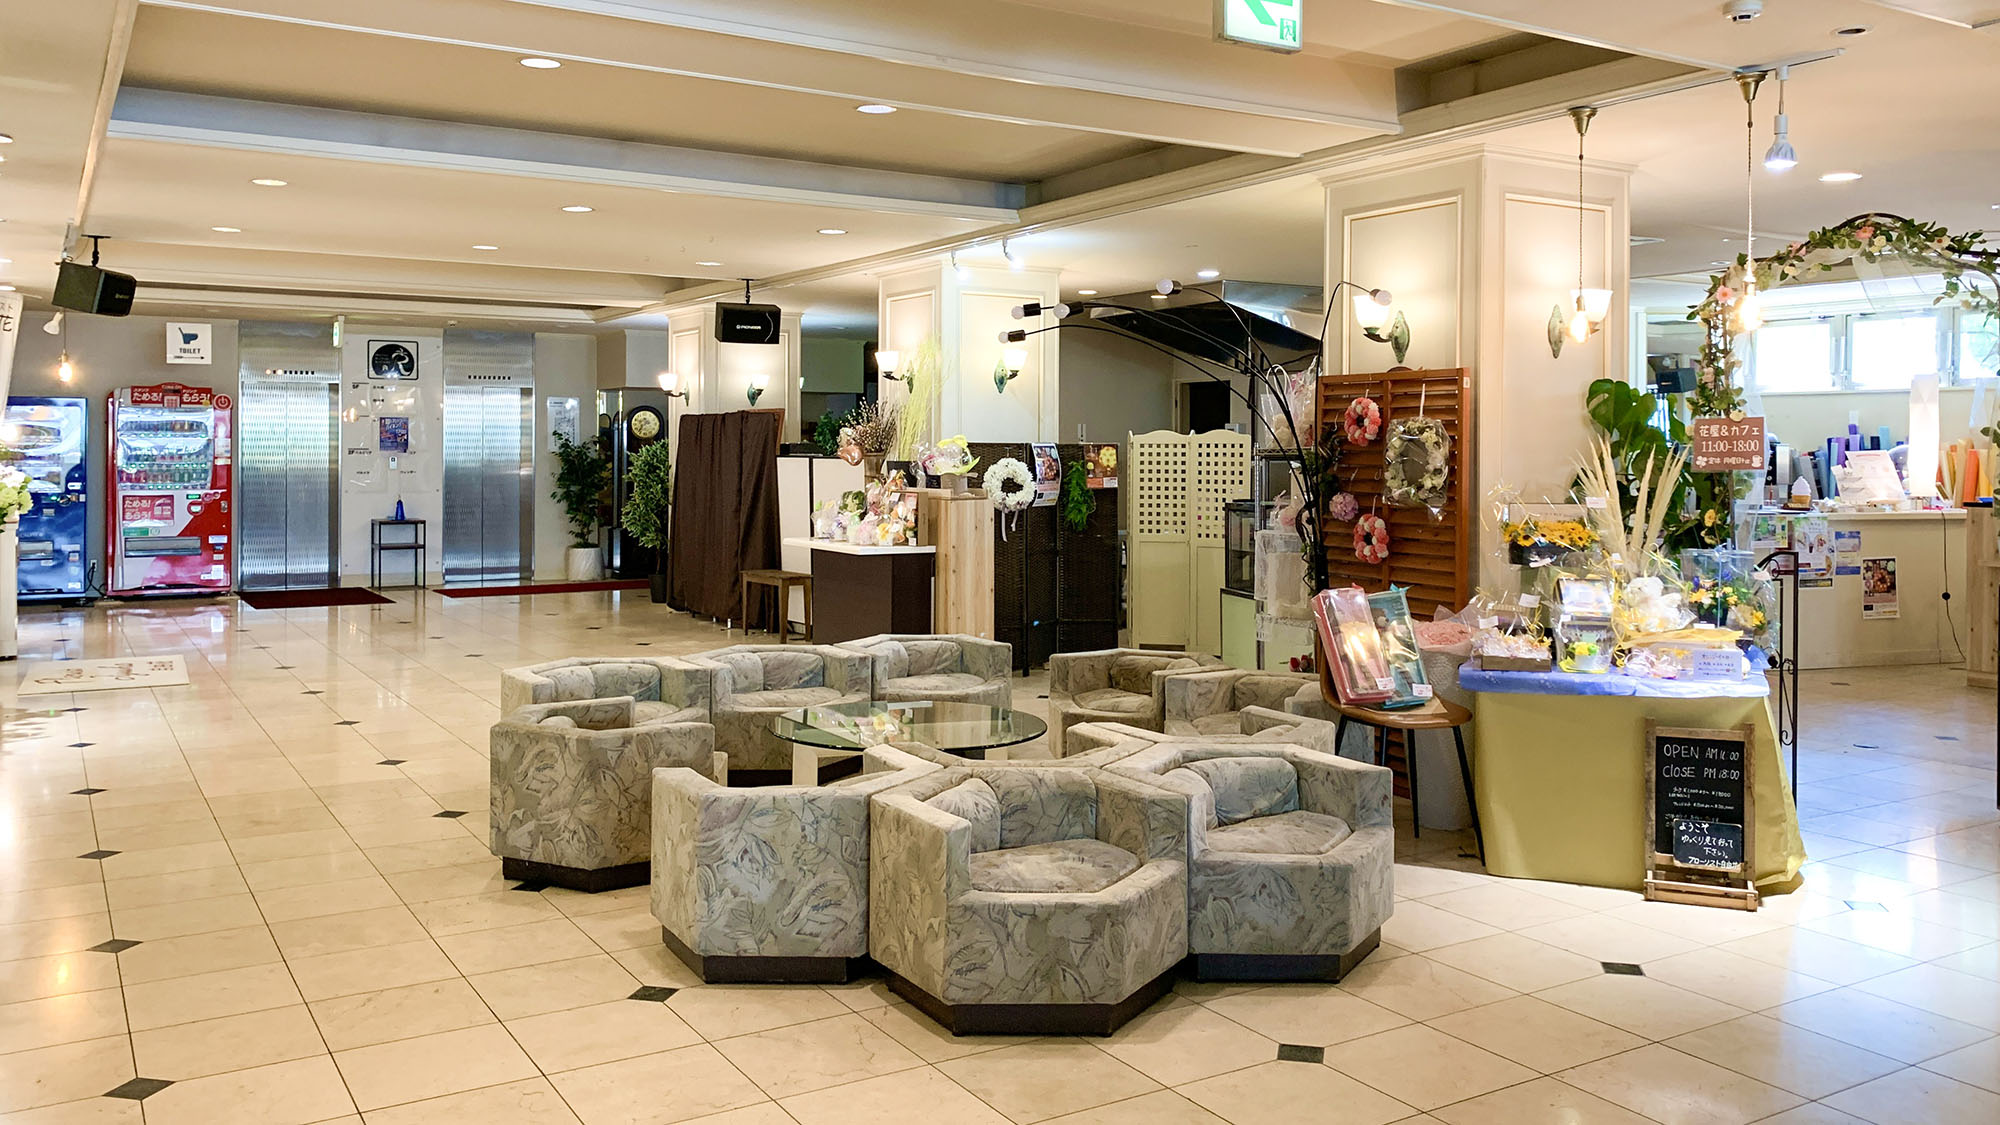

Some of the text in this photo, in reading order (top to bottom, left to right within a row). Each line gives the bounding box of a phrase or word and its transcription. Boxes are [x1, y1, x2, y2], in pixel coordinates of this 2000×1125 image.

[1699, 424, 1760, 438] 花屋&カフェ
[1701, 439, 1760, 453] 11:00-18:00
[1663, 743, 1700, 759] OPEN
[1703, 767, 1717, 779] PM
[1679, 822, 1709, 834] ようこそ
